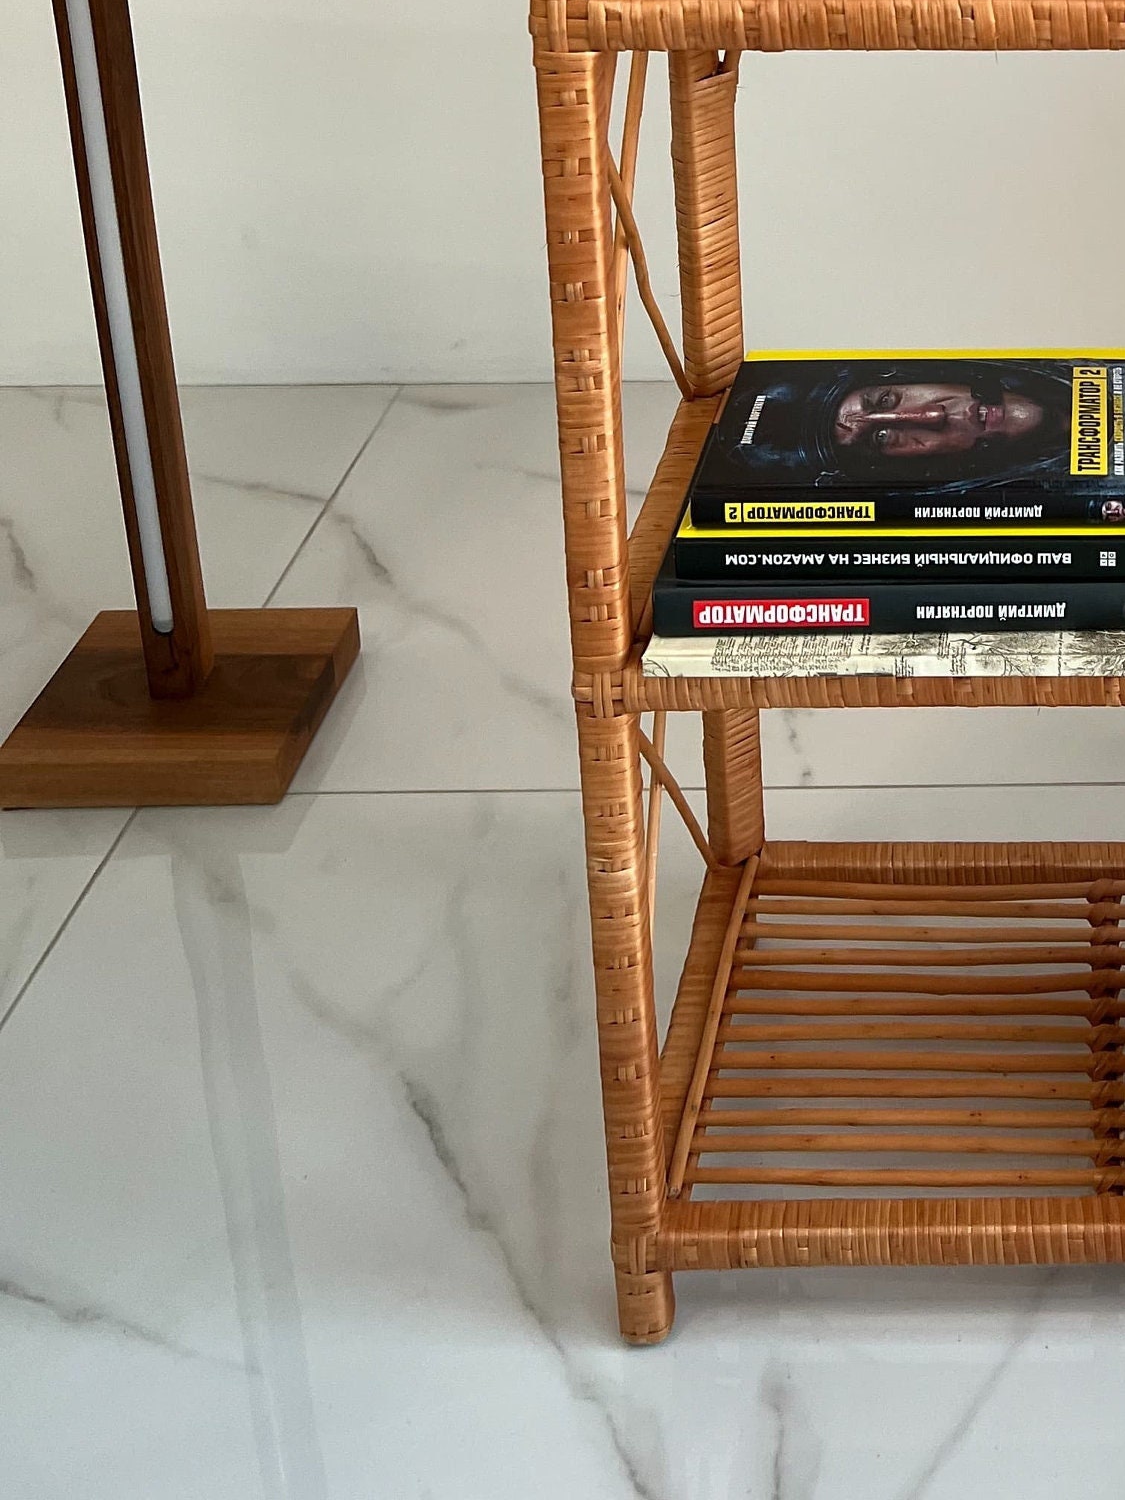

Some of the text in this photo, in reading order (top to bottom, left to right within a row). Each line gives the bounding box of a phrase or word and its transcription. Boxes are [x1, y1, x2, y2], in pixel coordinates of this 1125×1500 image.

[1078, 381, 1101, 471] ТРАНСФОРМАТОР
[728, 505, 871, 520] ТРАНСФОРМАТОР 2
[914, 504, 1043, 520] ДМИТРИЙ ПОРТНЯГИН
[725, 551, 1072, 568] ВАШ ОФИЦИАЛЬНЫЙ БИЗНЕС НА AMAZON.COM
[699, 603, 866, 624] ТРАНСФОРМАТОР
[916, 602, 1067, 621] ДМИТРИЙ ПОРТНЯГИН
